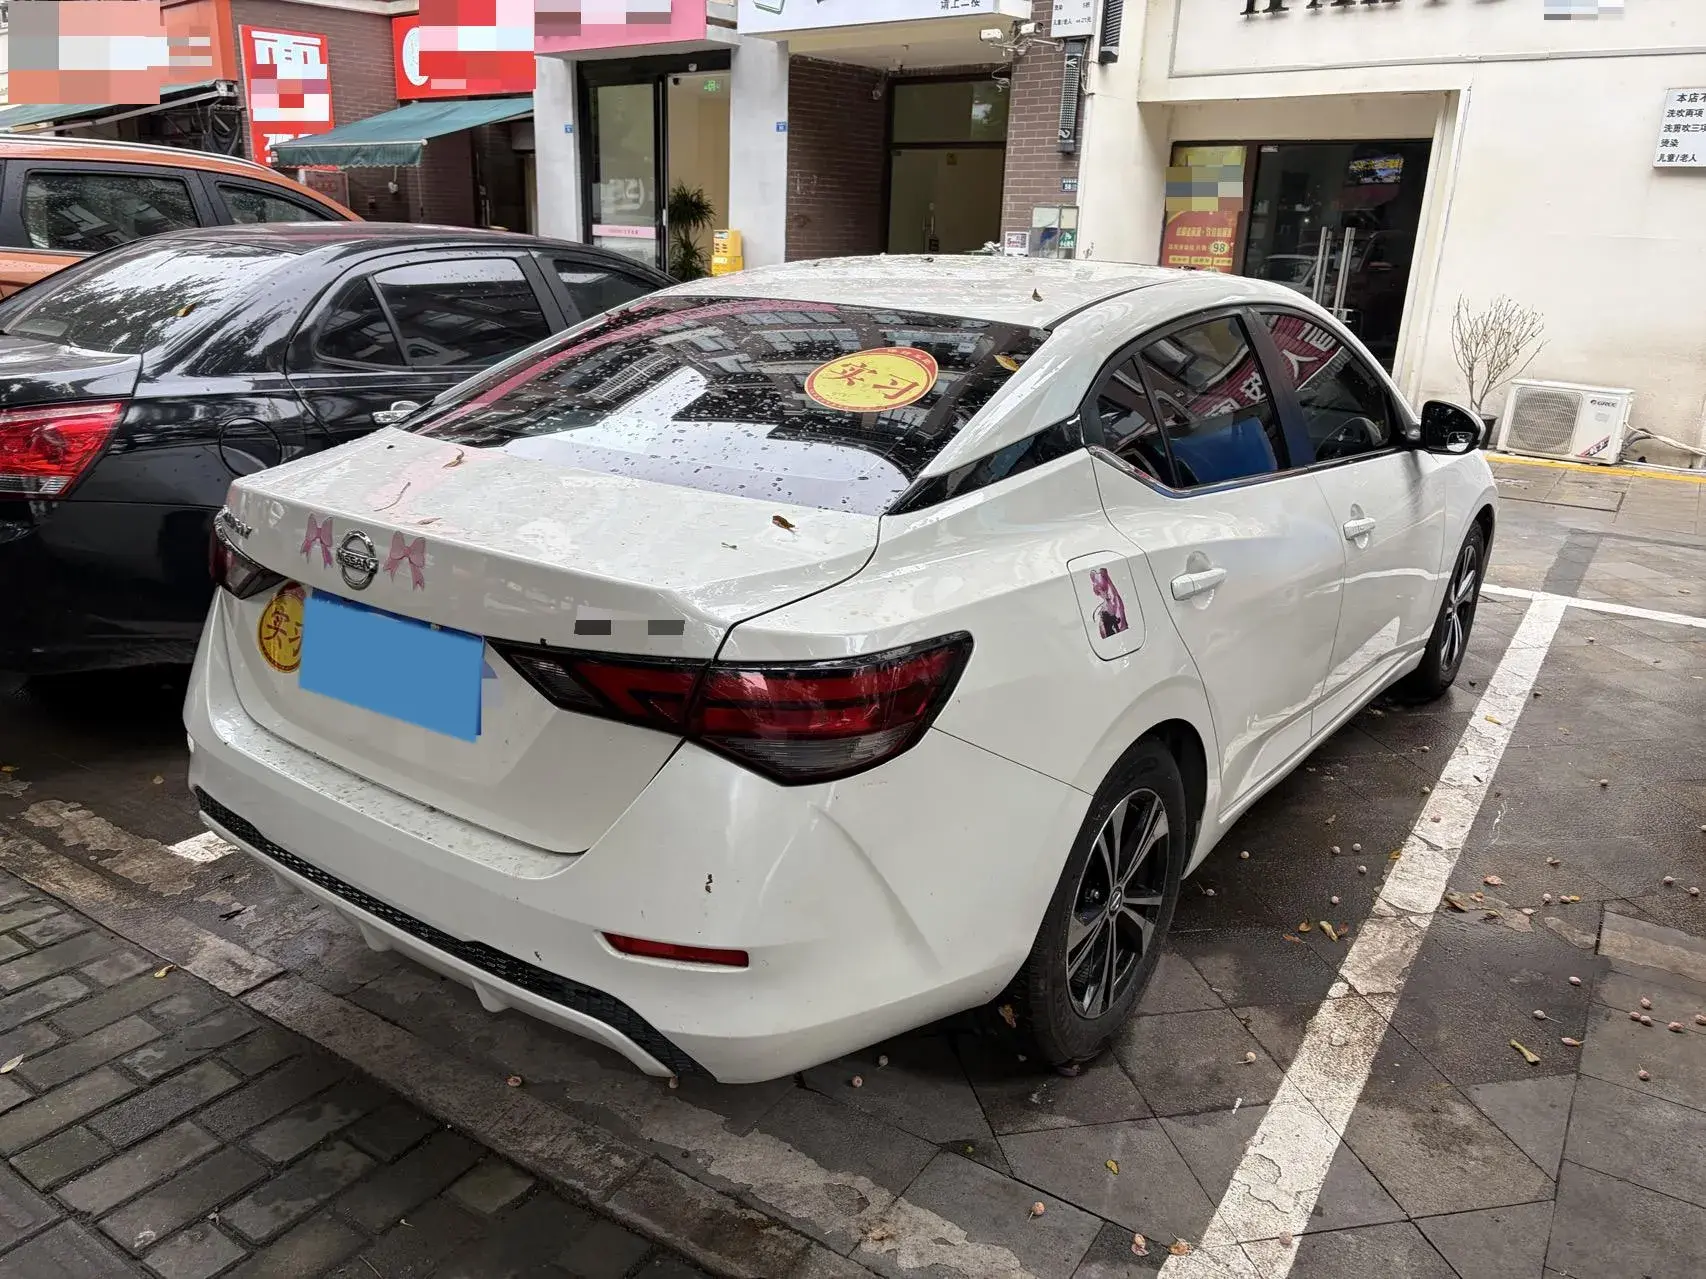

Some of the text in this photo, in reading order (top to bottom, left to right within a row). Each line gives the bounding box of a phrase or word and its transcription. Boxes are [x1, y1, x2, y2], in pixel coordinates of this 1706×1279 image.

[1666, 108, 1704, 118] 洗吹两项
[1660, 138, 1679, 148] 烫染
[1657, 153, 1697, 163] 儿童/老人
[1213, 243, 1226, 253] 98
[822, 362, 920, 400] 实习
